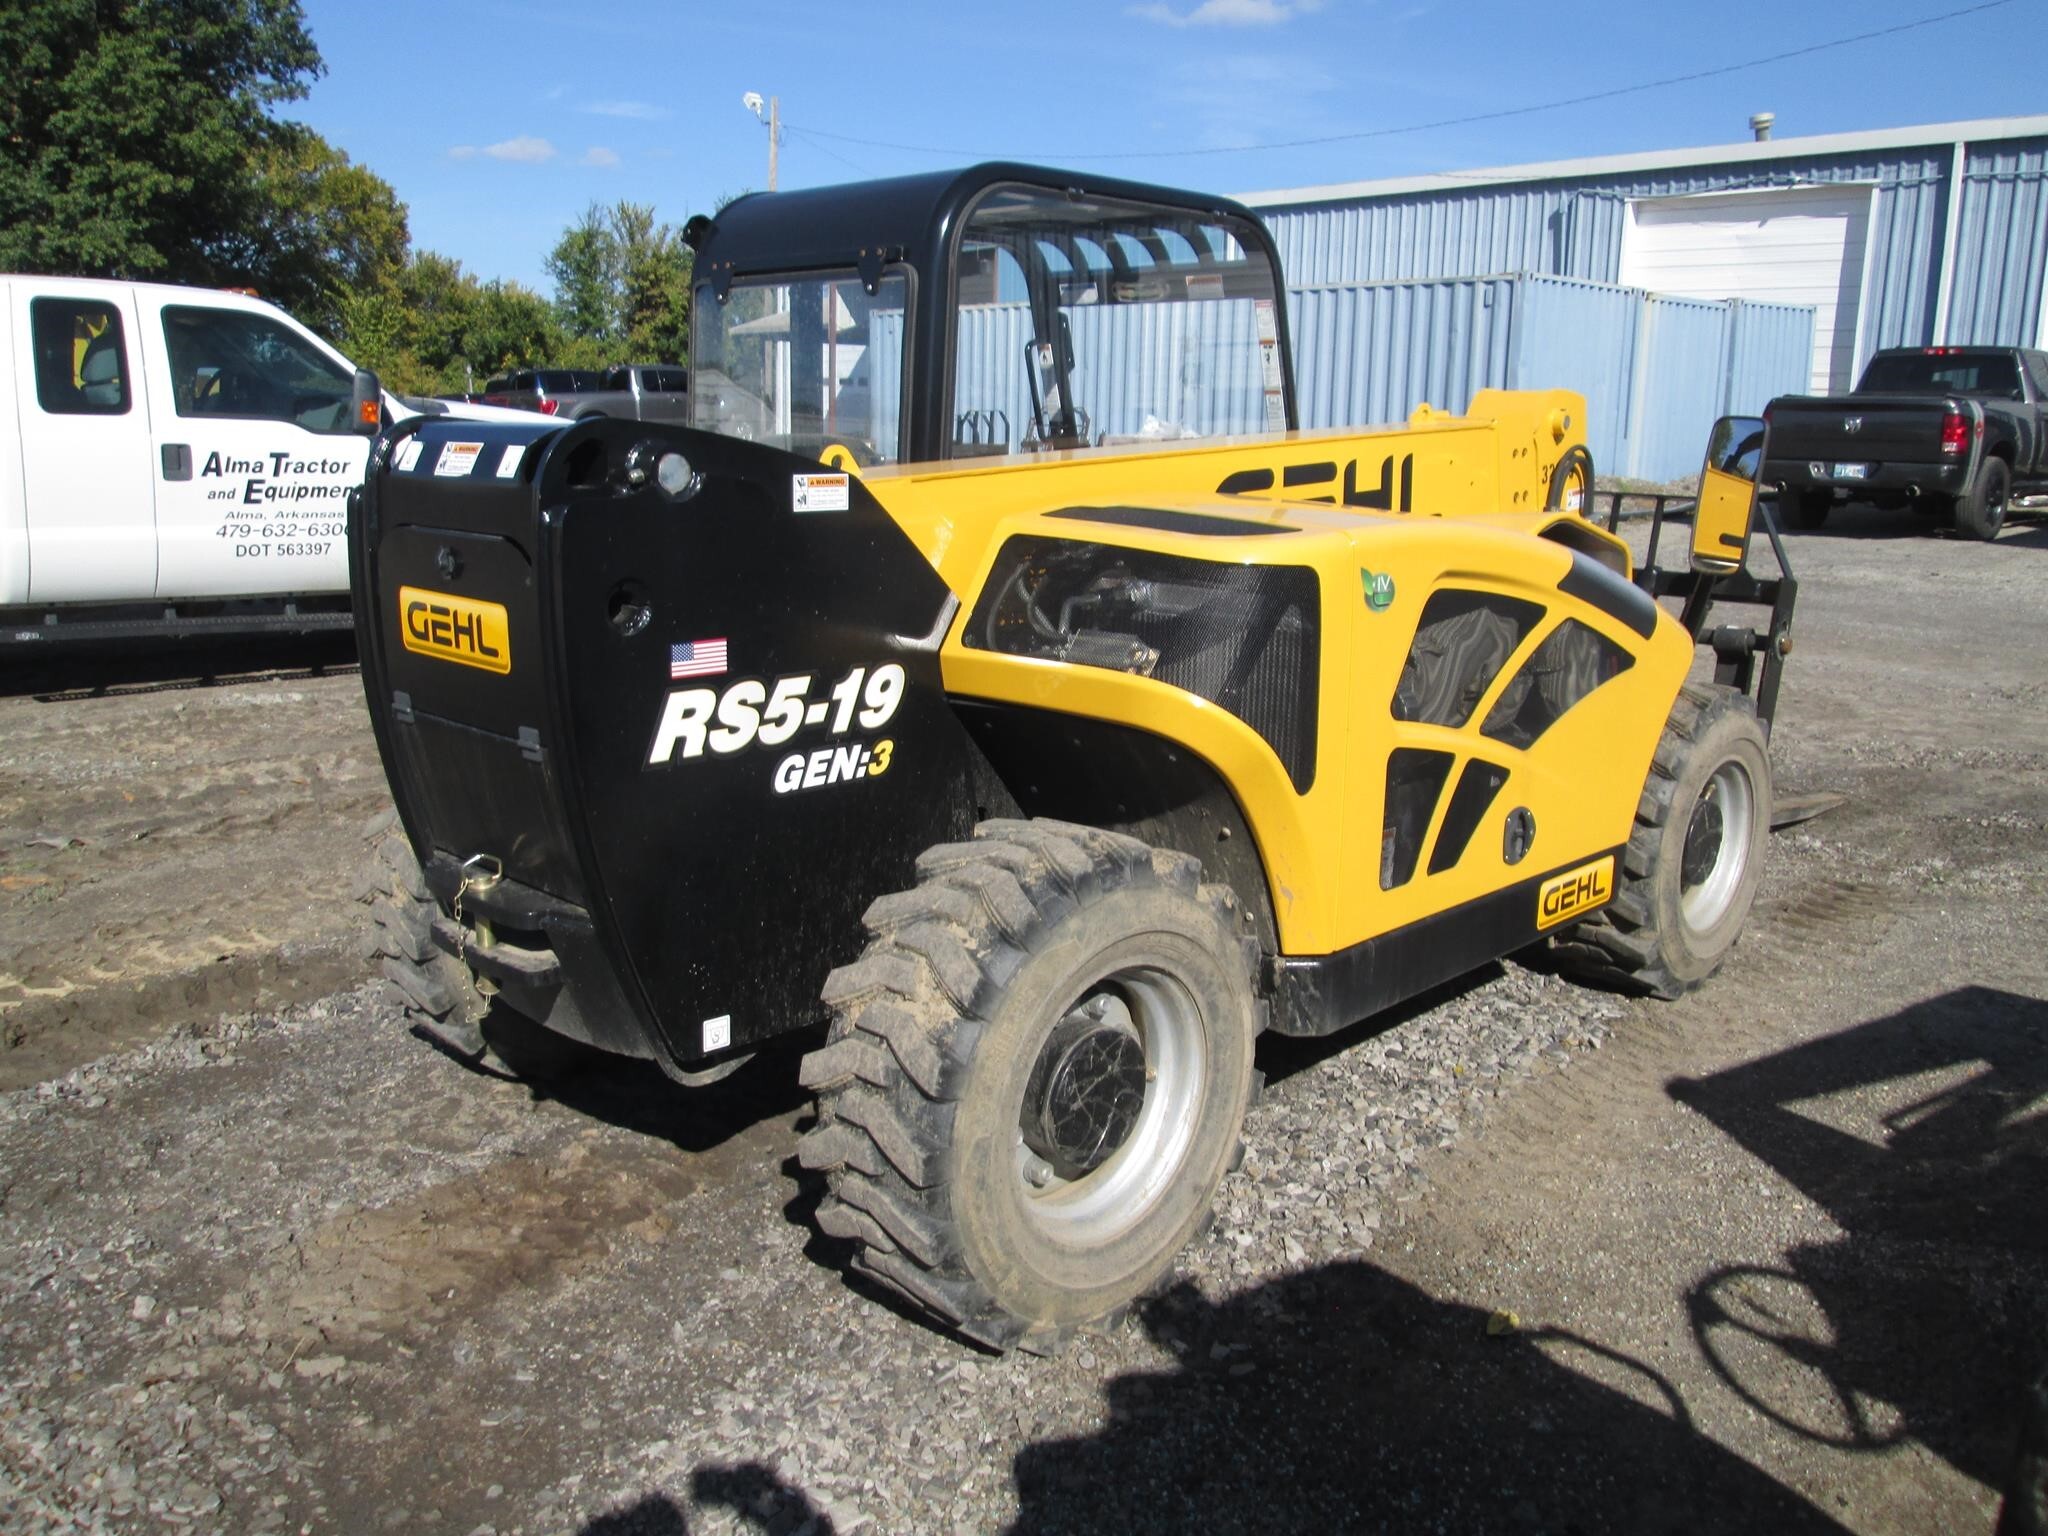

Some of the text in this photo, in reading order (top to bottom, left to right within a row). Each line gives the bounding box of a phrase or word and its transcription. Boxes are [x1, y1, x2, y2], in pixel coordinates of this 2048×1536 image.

[201, 451, 351, 477] Alma Tractor
[207, 479, 353, 505] and Equipmen
[225, 511, 345, 520] Alma, Arkansas
[236, 543, 332, 557] DOT 563397
[407, 600, 500, 659] GEHL
[649, 663, 906, 764] RS5-19
[1543, 869, 1606, 917] GEHL
